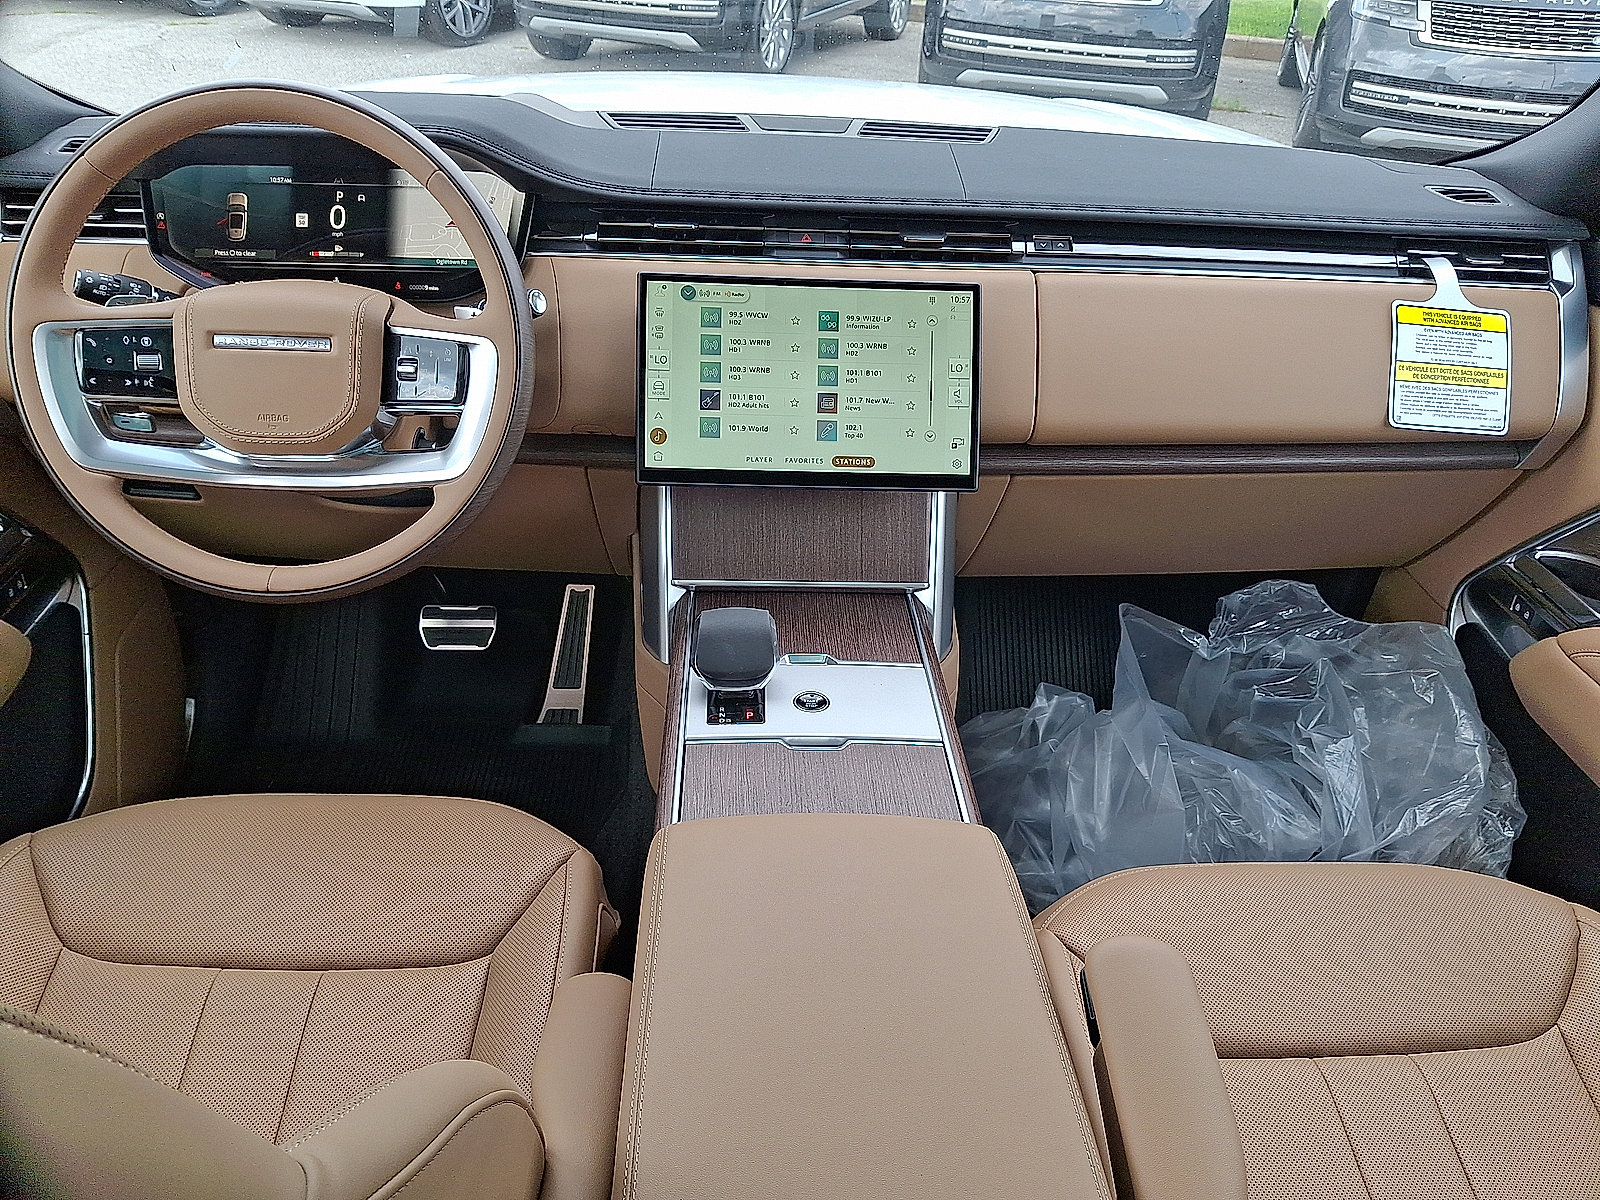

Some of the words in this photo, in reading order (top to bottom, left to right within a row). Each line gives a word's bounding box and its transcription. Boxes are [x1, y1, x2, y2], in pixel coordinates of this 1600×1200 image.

[336, 191, 344, 202] P
[330, 204, 346, 230] 0
[950, 296, 970, 304] 10:57
[654, 355, 668, 364] LO
[950, 364, 964, 373] LO
[257, 414, 289, 422] AIRBAG
